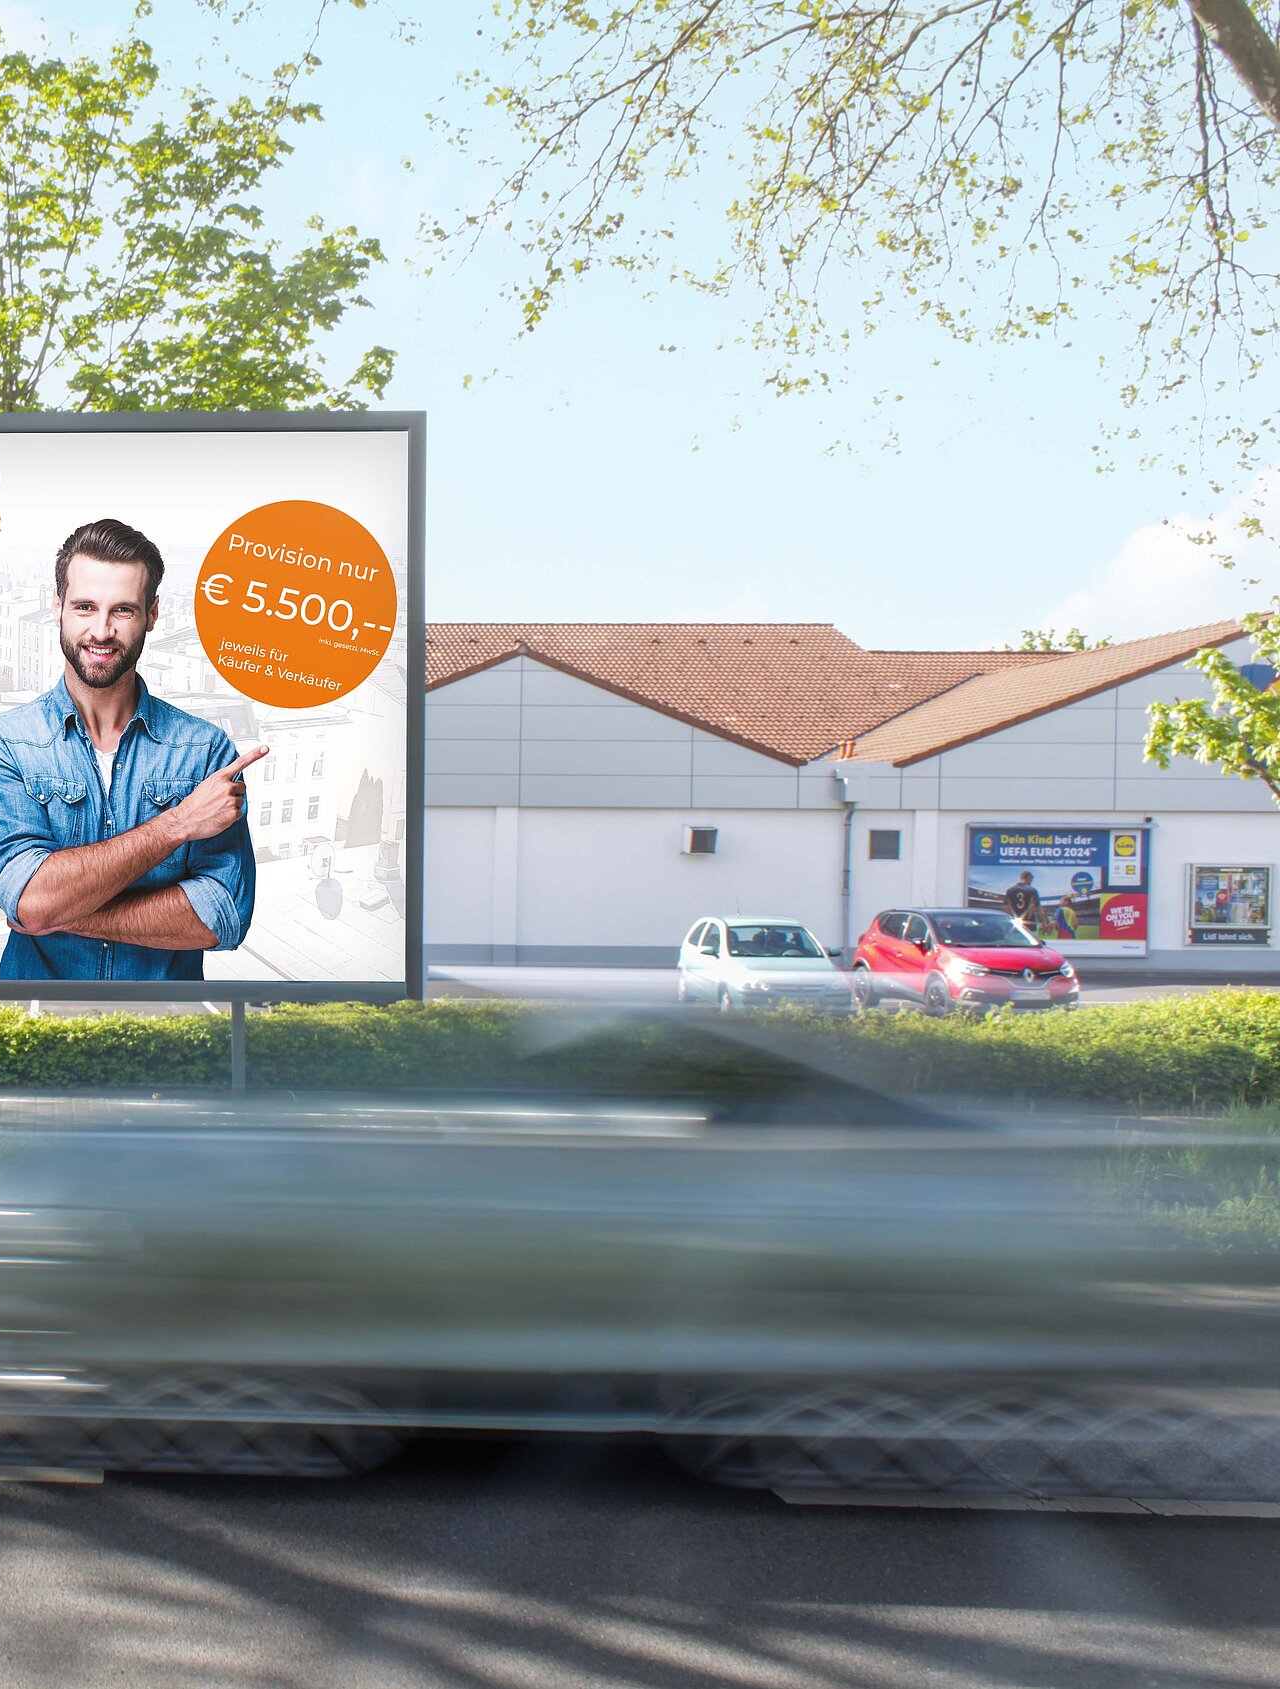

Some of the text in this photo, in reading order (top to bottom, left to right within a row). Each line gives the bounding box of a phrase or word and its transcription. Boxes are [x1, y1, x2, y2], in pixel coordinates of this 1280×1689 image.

[228, 533, 379, 582] Provision nur
[200, 573, 234, 606] €
[218, 637, 289, 663] jeweils für
[217, 654, 342, 692] Käufer & Verkäufer
[1000, 834, 1092, 845] Dein Kind bei der
[999, 847, 1028, 857] UEFA
[1030, 847, 1061, 857] EURO
[1119, 911, 1140, 920] YOUR
[1113, 918, 1134, 927] TEAM
[1203, 933, 1217, 941] Lidl
[1218, 933, 1237, 941] lohnt
